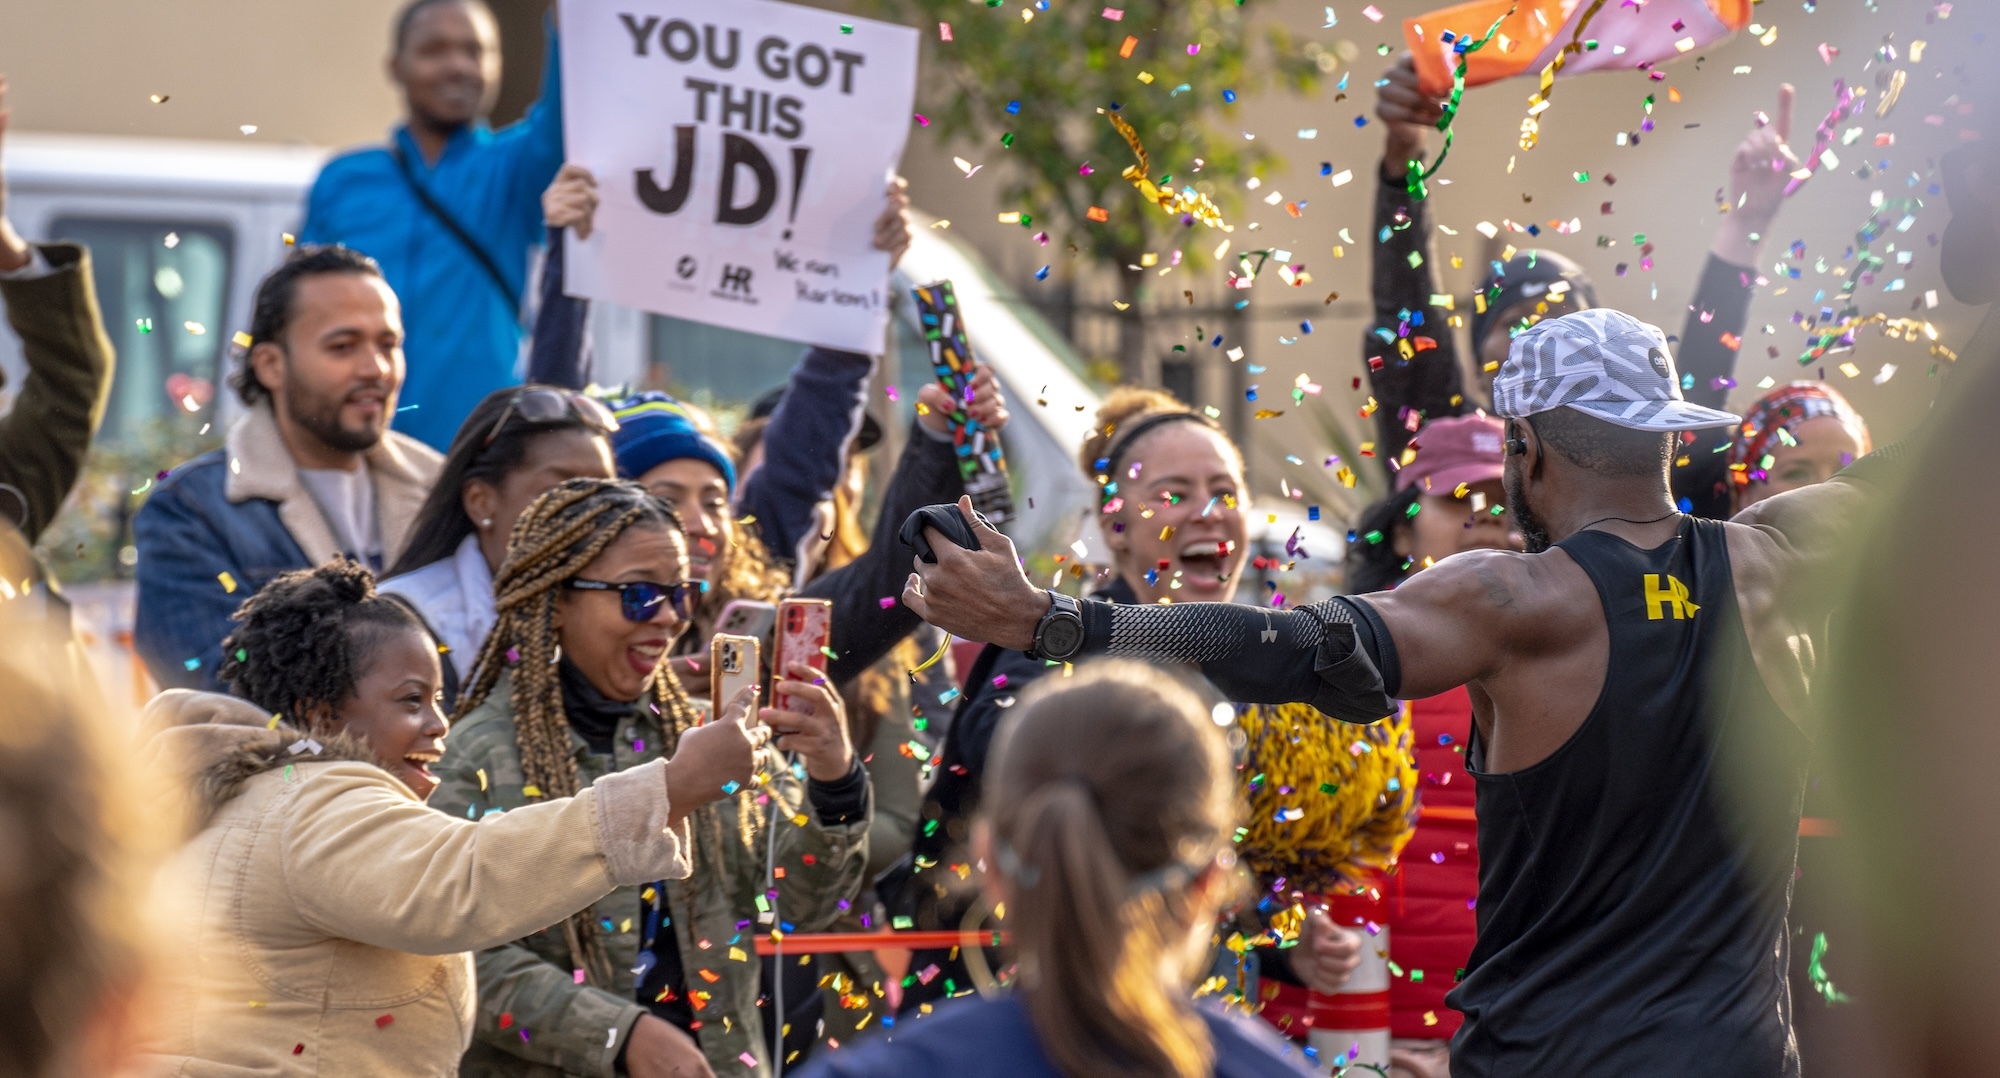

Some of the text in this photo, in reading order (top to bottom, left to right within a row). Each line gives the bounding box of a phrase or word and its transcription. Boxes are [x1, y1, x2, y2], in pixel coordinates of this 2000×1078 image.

[617, 13, 866, 95] YOU GOT
[684, 77, 805, 140] THIS
[720, 263, 754, 293] HR
[773, 248, 839, 278] We run
[1643, 573, 1701, 620] HR
